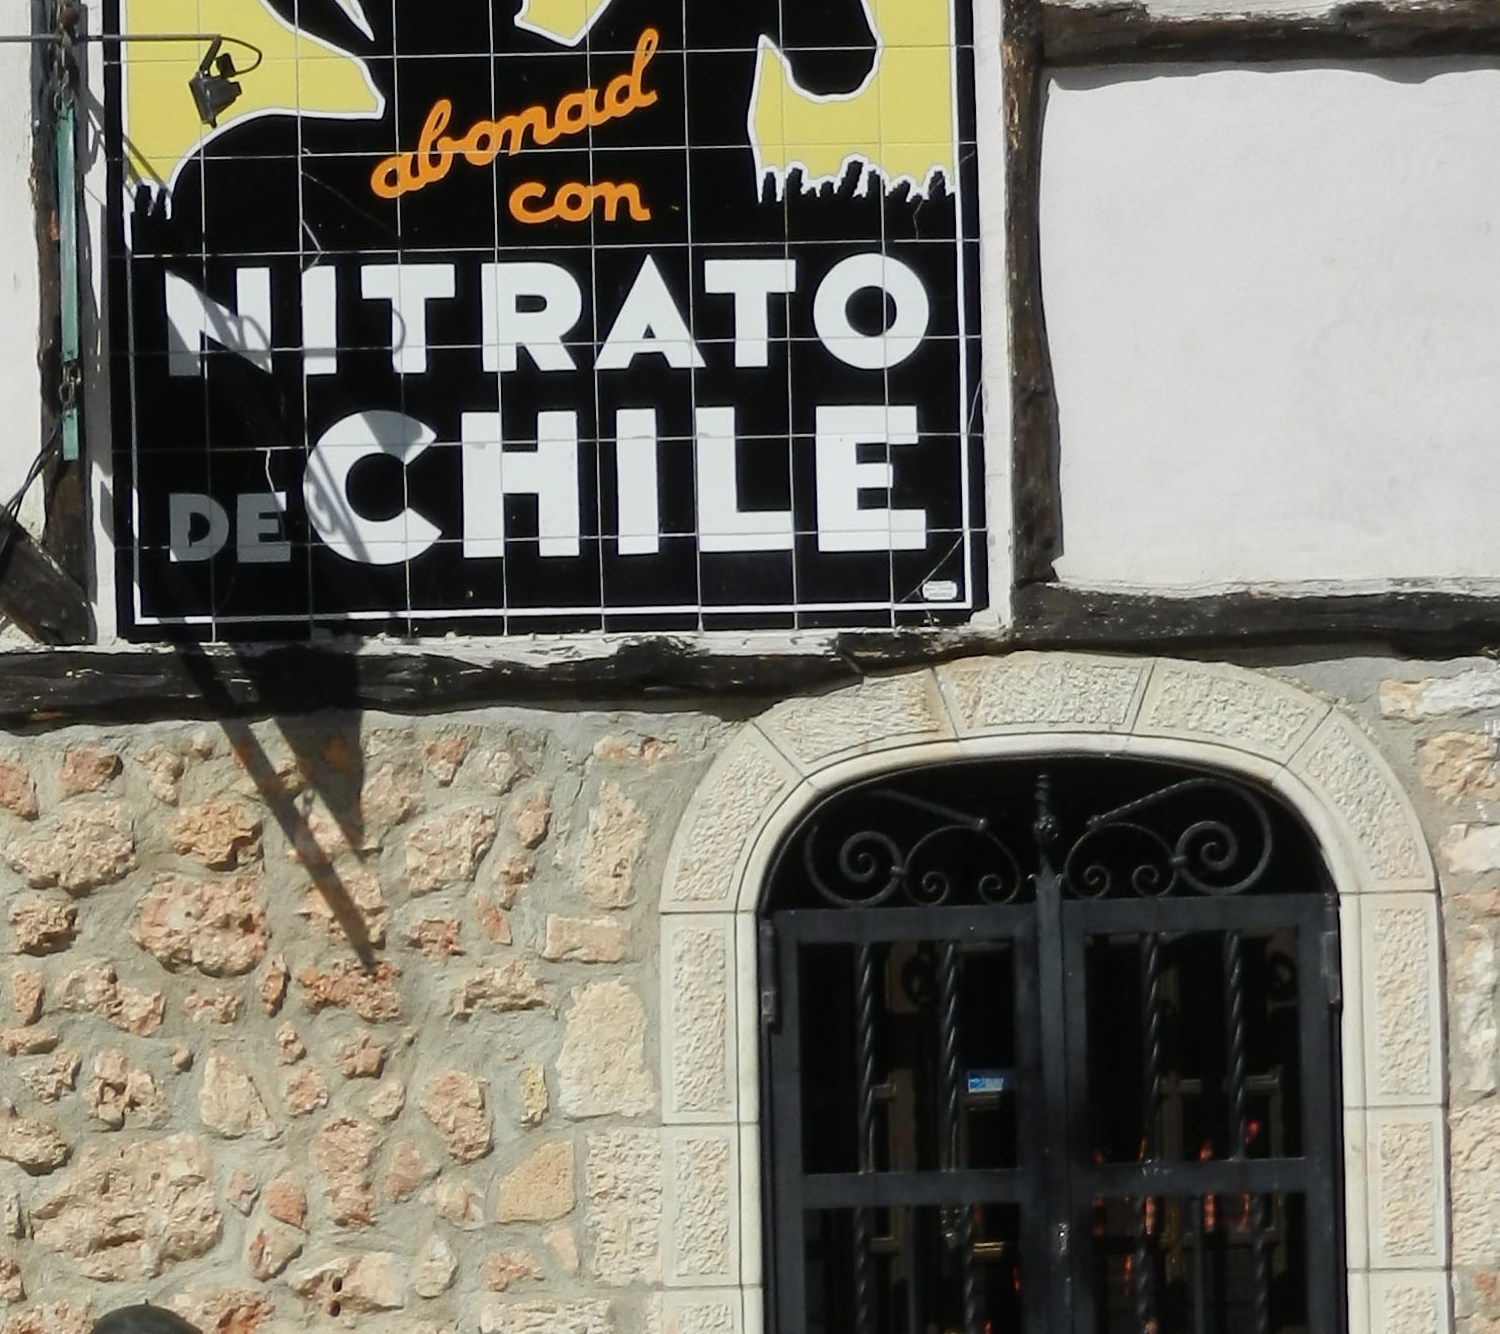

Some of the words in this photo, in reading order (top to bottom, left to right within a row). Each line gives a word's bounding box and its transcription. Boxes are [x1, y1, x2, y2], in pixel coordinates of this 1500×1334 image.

[370, 28, 659, 199] abonad
[508, 181, 651, 224] con
[164, 253, 931, 378] NITRATO
[168, 490, 292, 564] DE
[303, 405, 928, 566] CHILE
